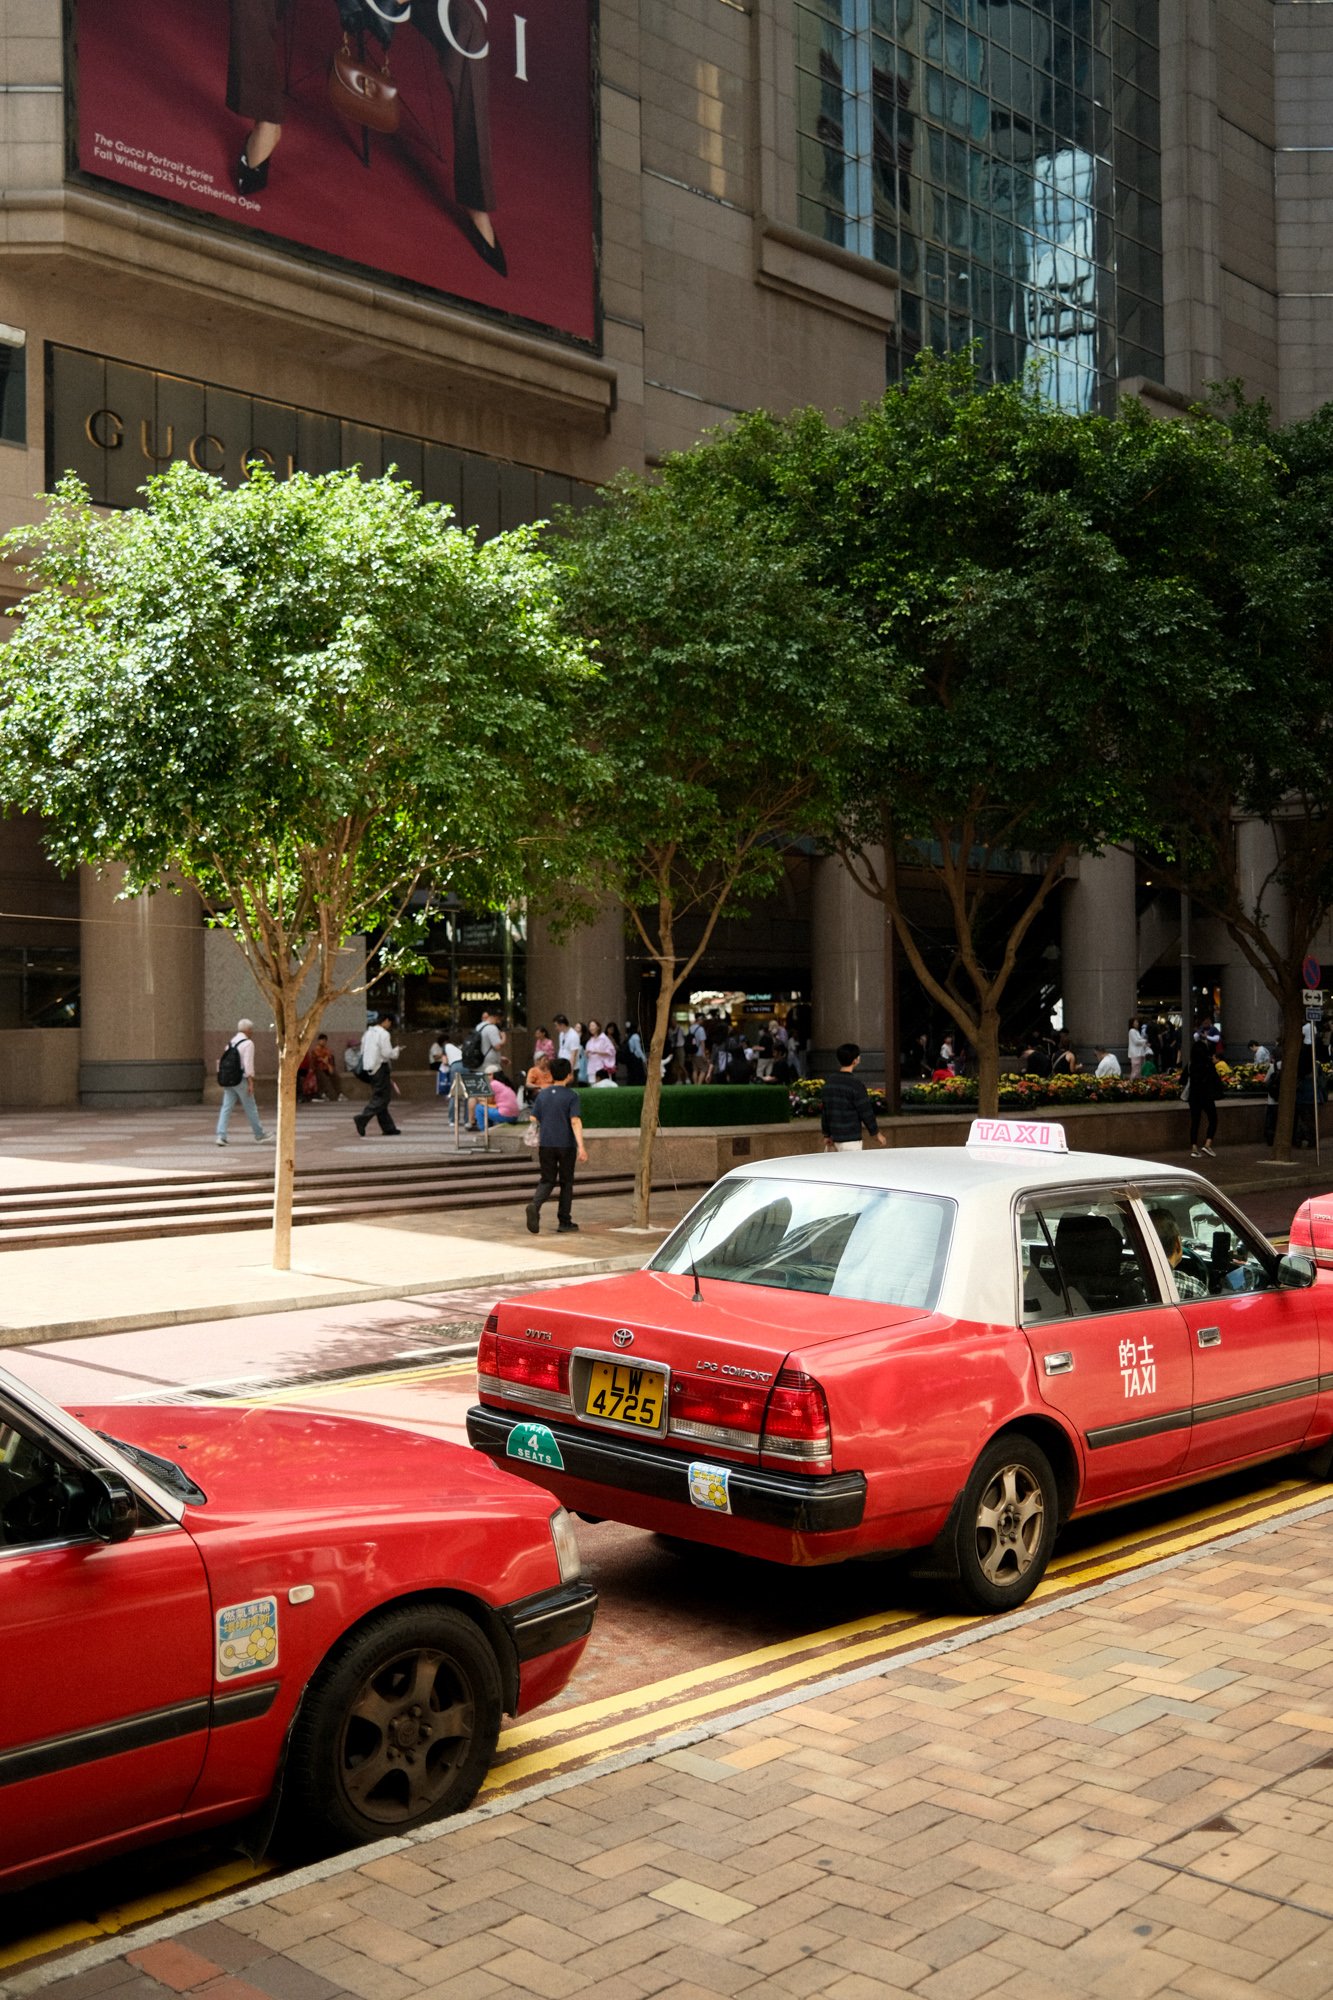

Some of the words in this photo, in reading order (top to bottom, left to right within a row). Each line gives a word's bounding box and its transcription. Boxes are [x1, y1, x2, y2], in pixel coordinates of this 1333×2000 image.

[94, 133, 113, 148] The
[115, 140, 145, 159] Gucci
[147, 151, 184, 174] Portrait
[186, 165, 214, 183] Series
[94, 147, 113, 161] Fall
[114, 153, 148, 173] Winter
[150, 166, 174, 183] 2025
[176, 174, 189, 189] by
[190, 181, 237, 204] Catherine
[238, 197, 261, 212] Opie
[977, 1122, 1050, 1145] TAXI
[1119, 1335, 1154, 1367] 的士
[611, 1366, 643, 1395] LW
[696, 1360, 719, 1372] LPG
[721, 1364, 773, 1382] COMFORT
[1120, 1364, 1156, 1398] TAXI
[592, 1389, 656, 1424] 4725
[517, 1448, 552, 1464] SEATS
[527, 1434, 539, 1451] 4
